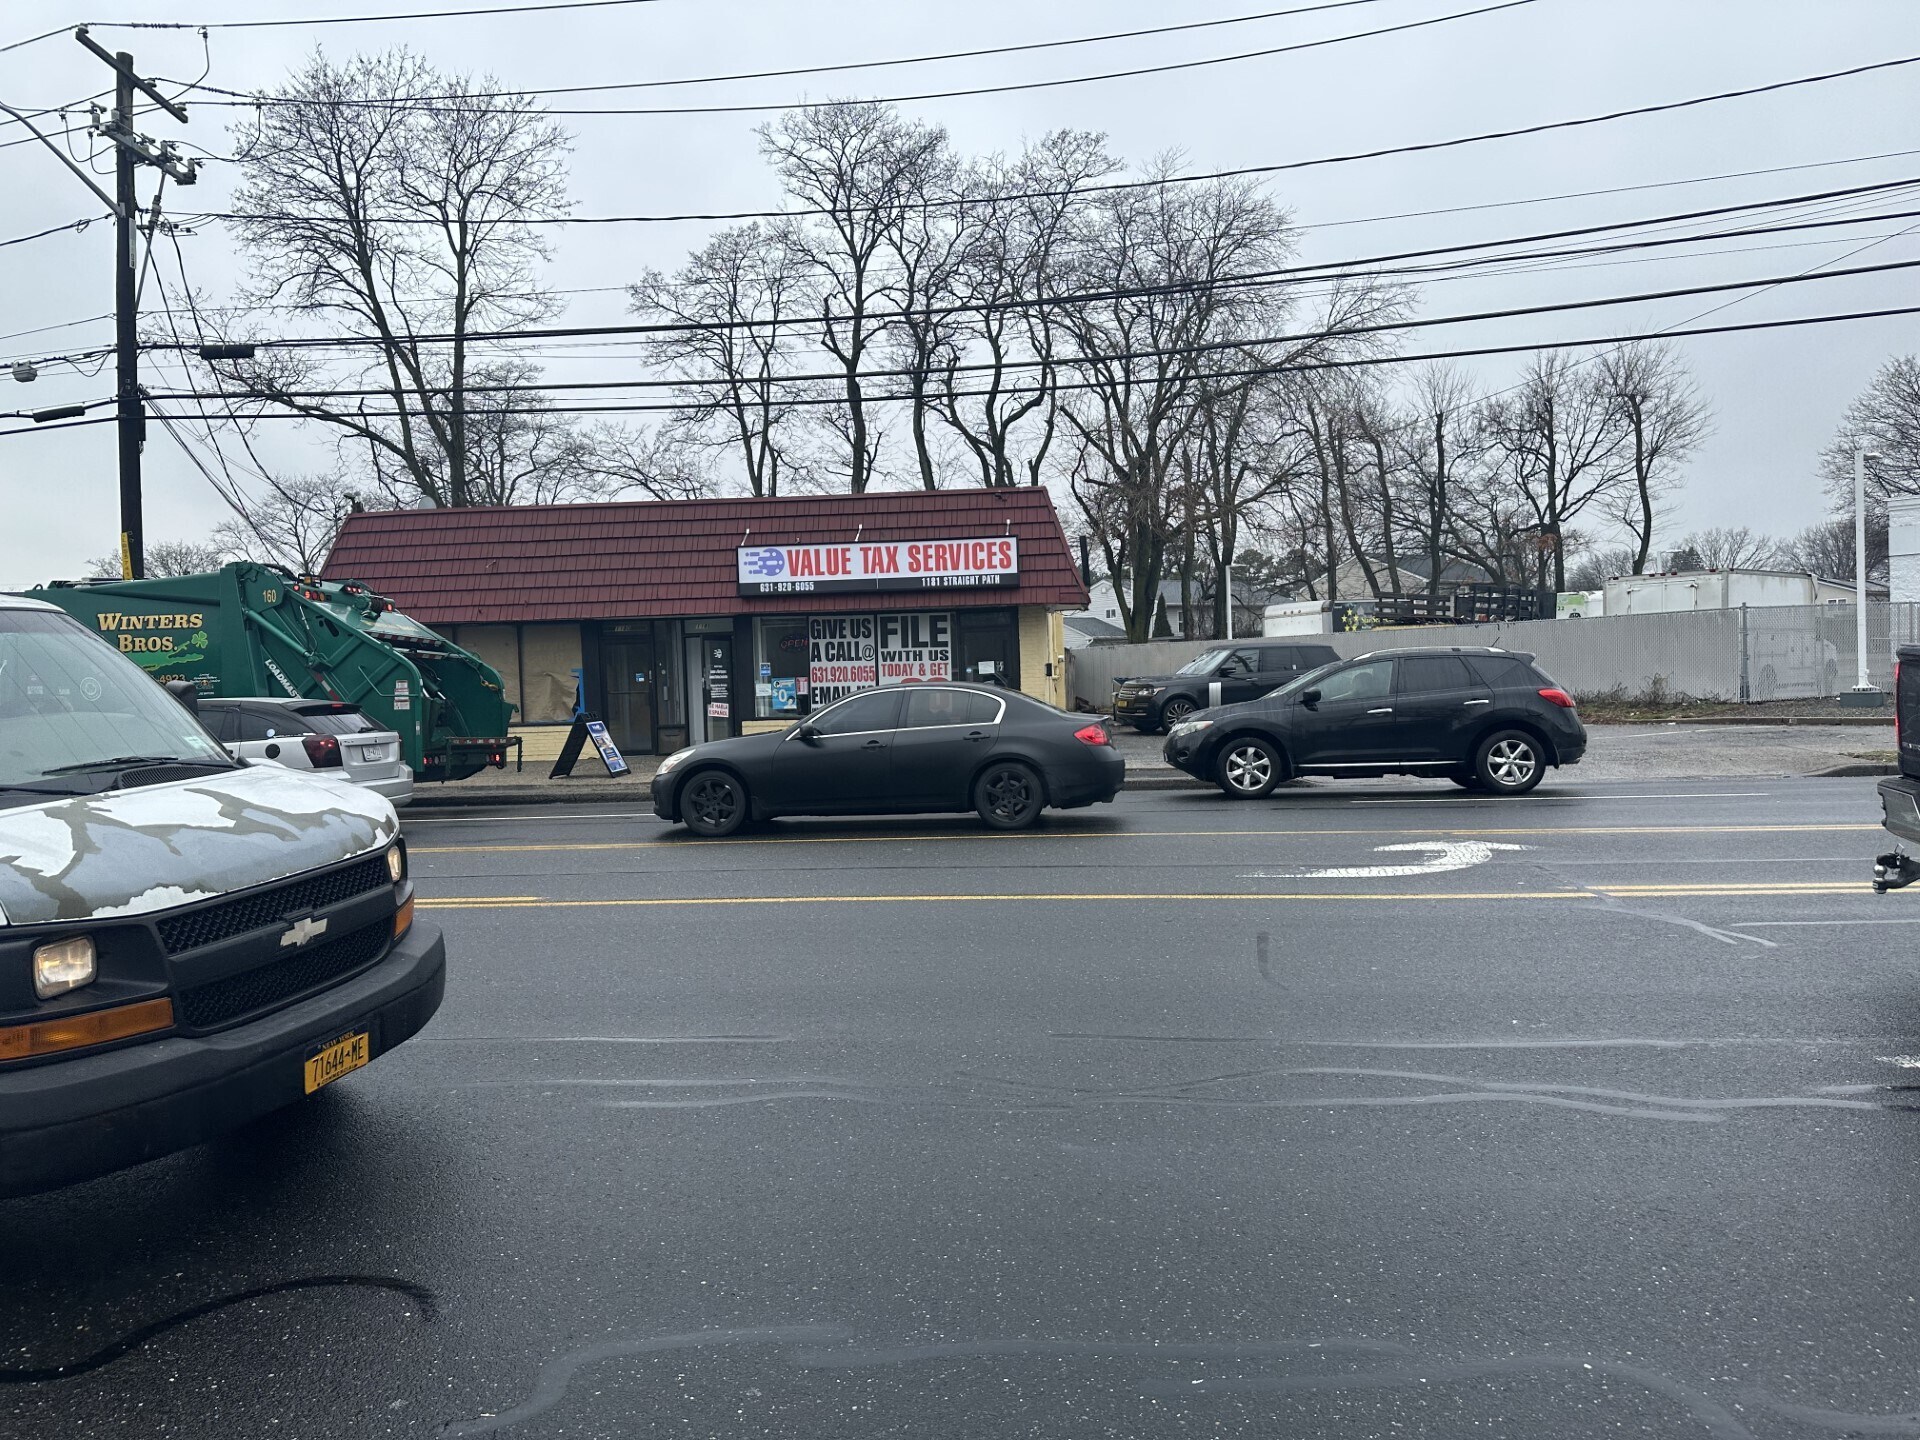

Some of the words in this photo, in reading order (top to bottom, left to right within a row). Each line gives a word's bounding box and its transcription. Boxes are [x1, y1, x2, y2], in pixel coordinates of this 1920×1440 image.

[787, 547, 852, 577] VALUE
[860, 546, 900, 575] TAX
[907, 540, 1012, 573] SERVICES
[760, 581, 815, 592] 631-920-6055
[921, 577, 940, 587] 1181
[943, 575, 979, 586] STRAIGHT
[981, 574, 1000, 585] PATH
[262, 589, 277, 603] 160
[97, 612, 203, 631] WINTERS
[810, 618, 847, 640] GIVE
[850, 617, 872, 639] US
[880, 614, 949, 649] FILE
[117, 633, 178, 652] BROS.
[780, 639, 808, 648] OPEN
[810, 642, 822, 662] A
[825, 640, 875, 662] CALL@
[881, 649, 923, 662] WITH
[928, 649, 949, 662] US
[811, 665, 875, 683] 631.920.6055
[881, 663, 914, 677] TODAY
[918, 663, 927, 676] &
[930, 662, 949, 676] GET
